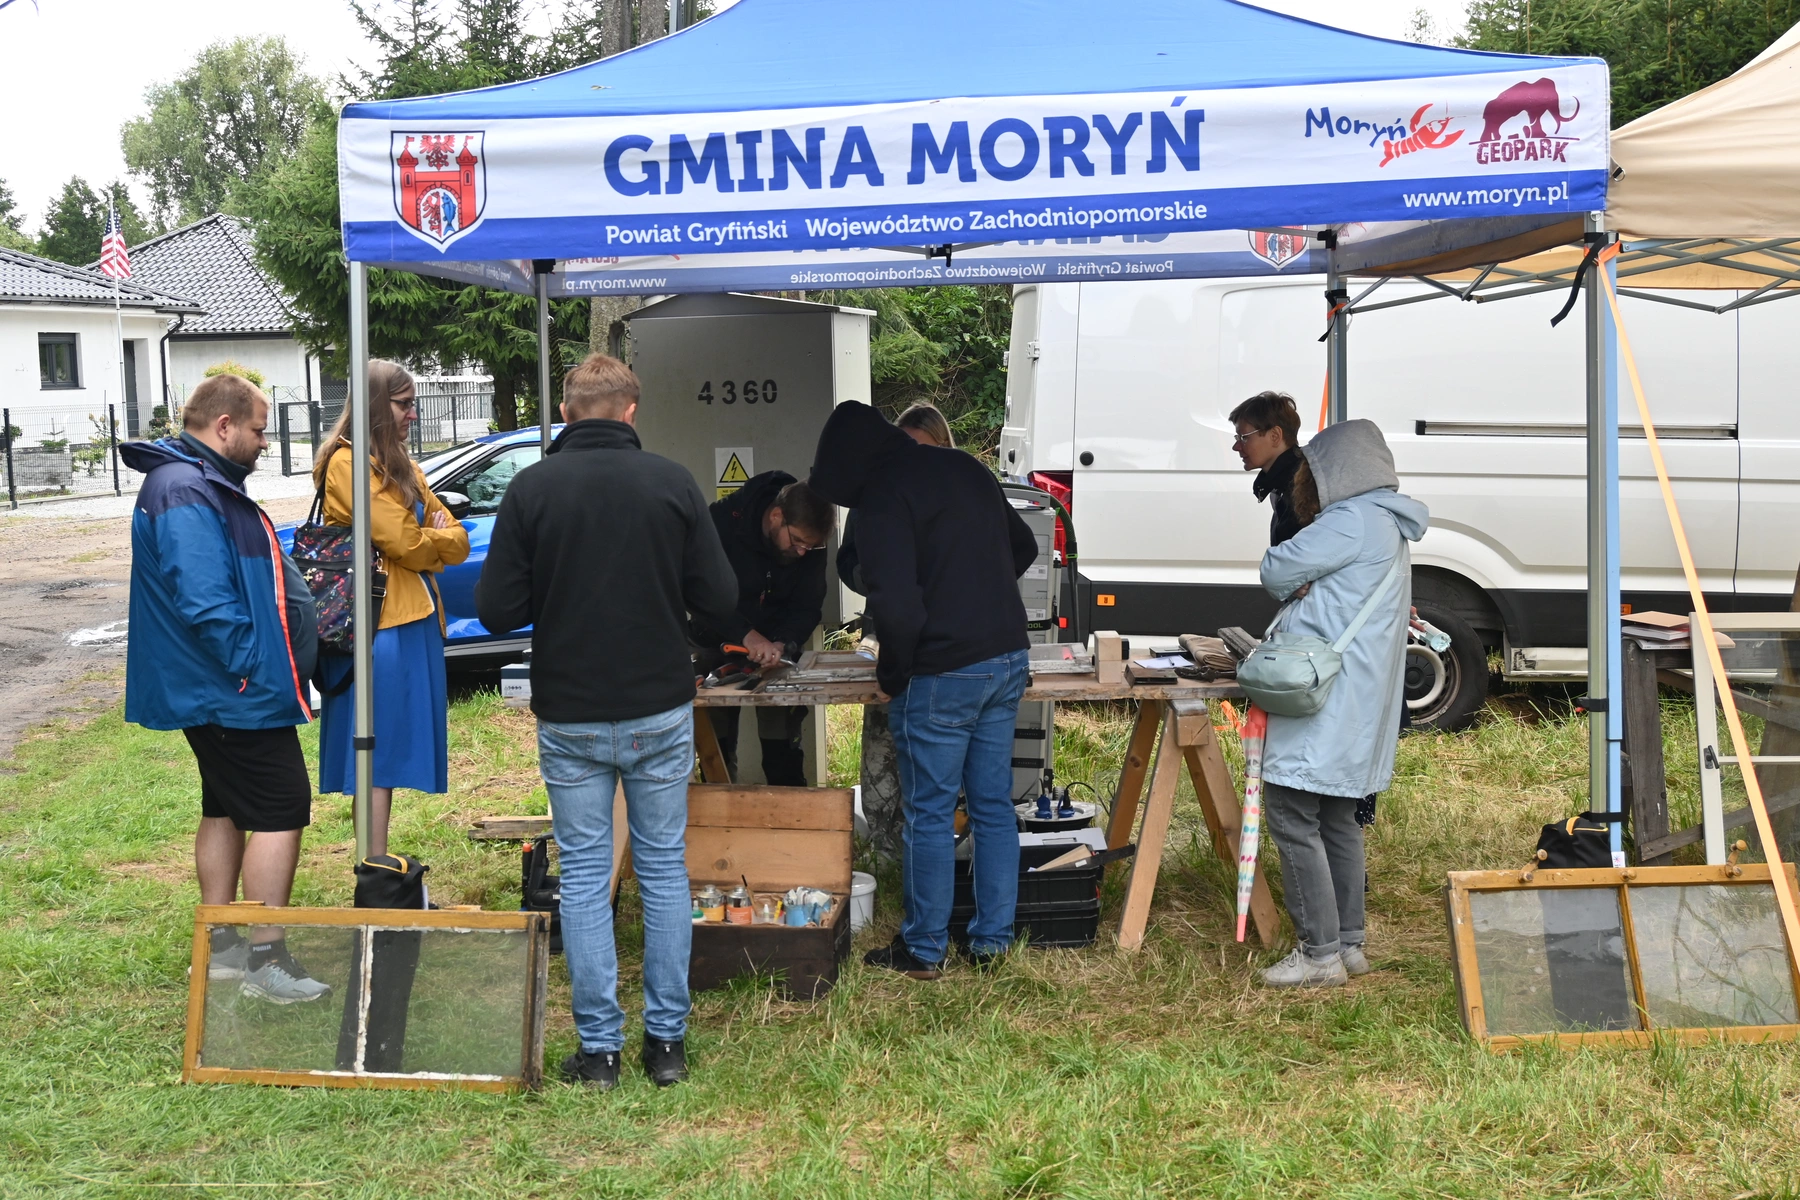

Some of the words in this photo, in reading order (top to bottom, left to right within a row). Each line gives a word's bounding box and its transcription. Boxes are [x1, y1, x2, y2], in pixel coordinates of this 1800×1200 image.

[1304, 107, 1406, 148] Moryń
[603, 125, 884, 197] GMINA
[907, 96, 1205, 185] MORYŃ
[1476, 138, 1569, 165] GEOPARK
[1403, 182, 1569, 208] www.moryn.pl
[606, 223, 681, 245] Powiat
[687, 219, 788, 246] Gryfiński
[805, 215, 964, 241] Województwo
[969, 201, 1208, 232] Zachodniopomorskie
[698, 378, 778, 405] 4360
